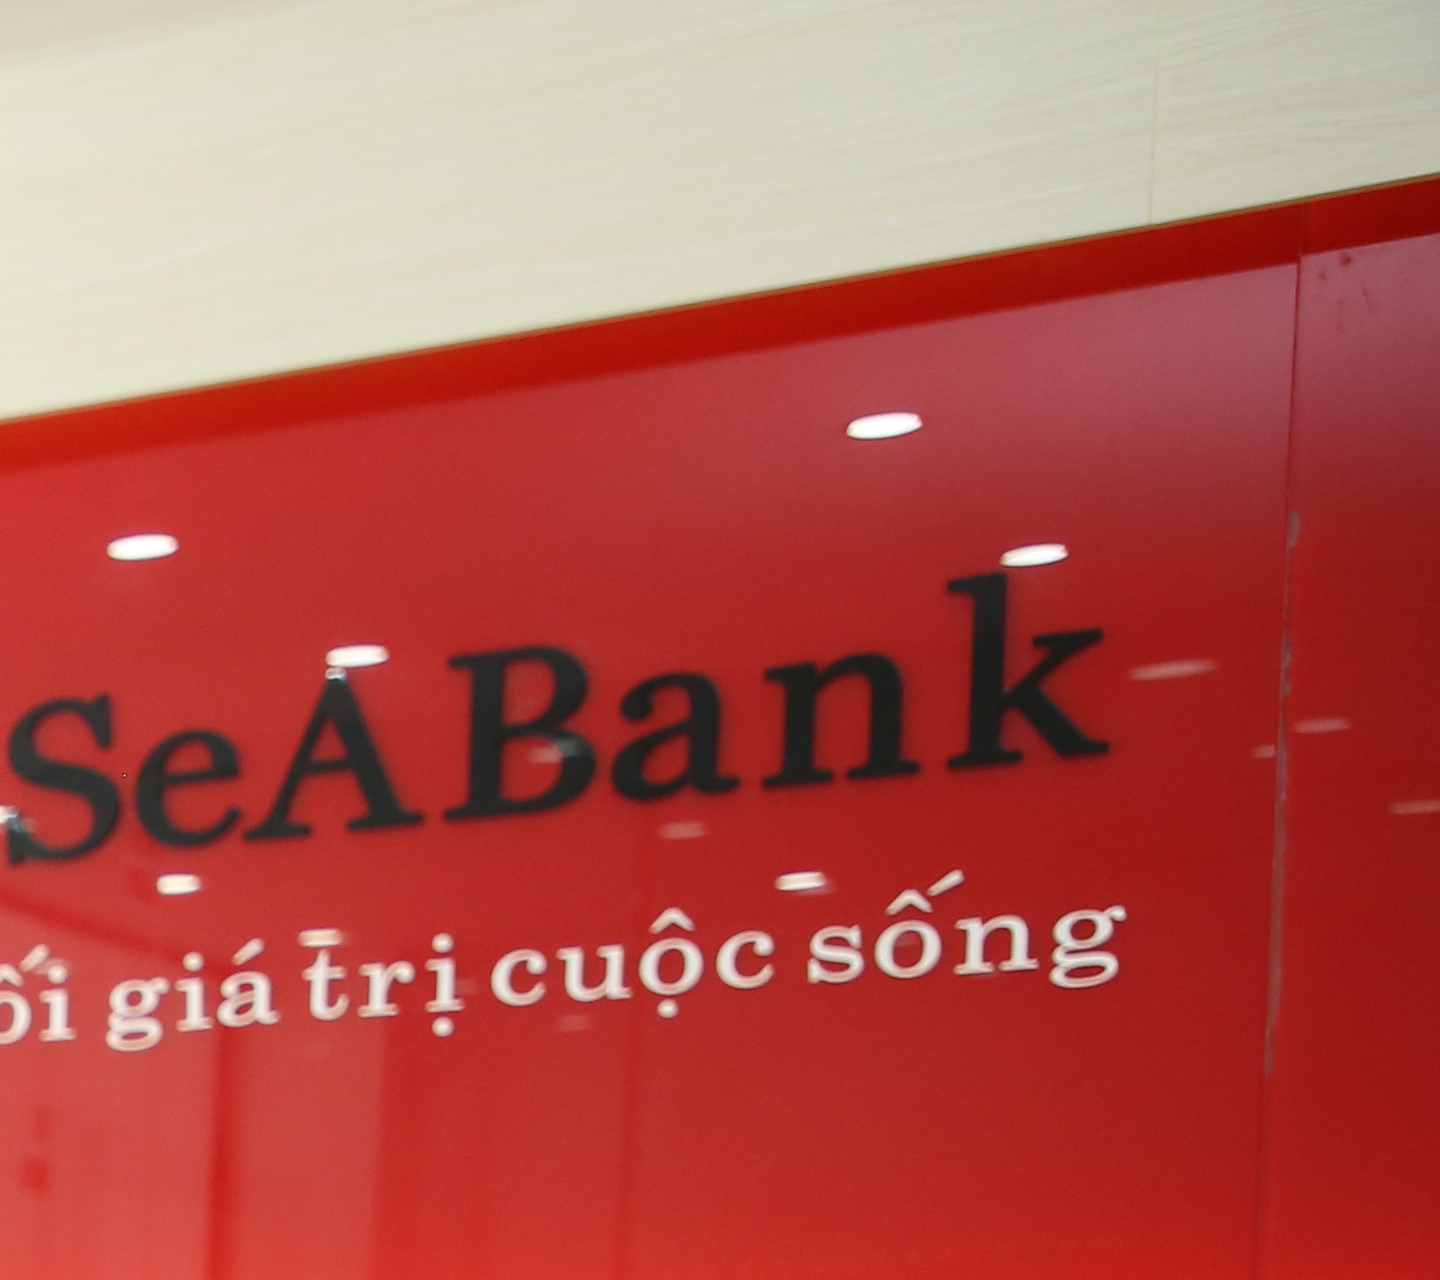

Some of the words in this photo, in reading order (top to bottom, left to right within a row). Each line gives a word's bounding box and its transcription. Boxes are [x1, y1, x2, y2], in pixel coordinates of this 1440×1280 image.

[3, 572, 1114, 865] SeABank
[105, 937, 280, 1053] giá
[301, 932, 464, 1037] trị
[489, 906, 775, 1018] cuộc
[806, 868, 1127, 989] sống
